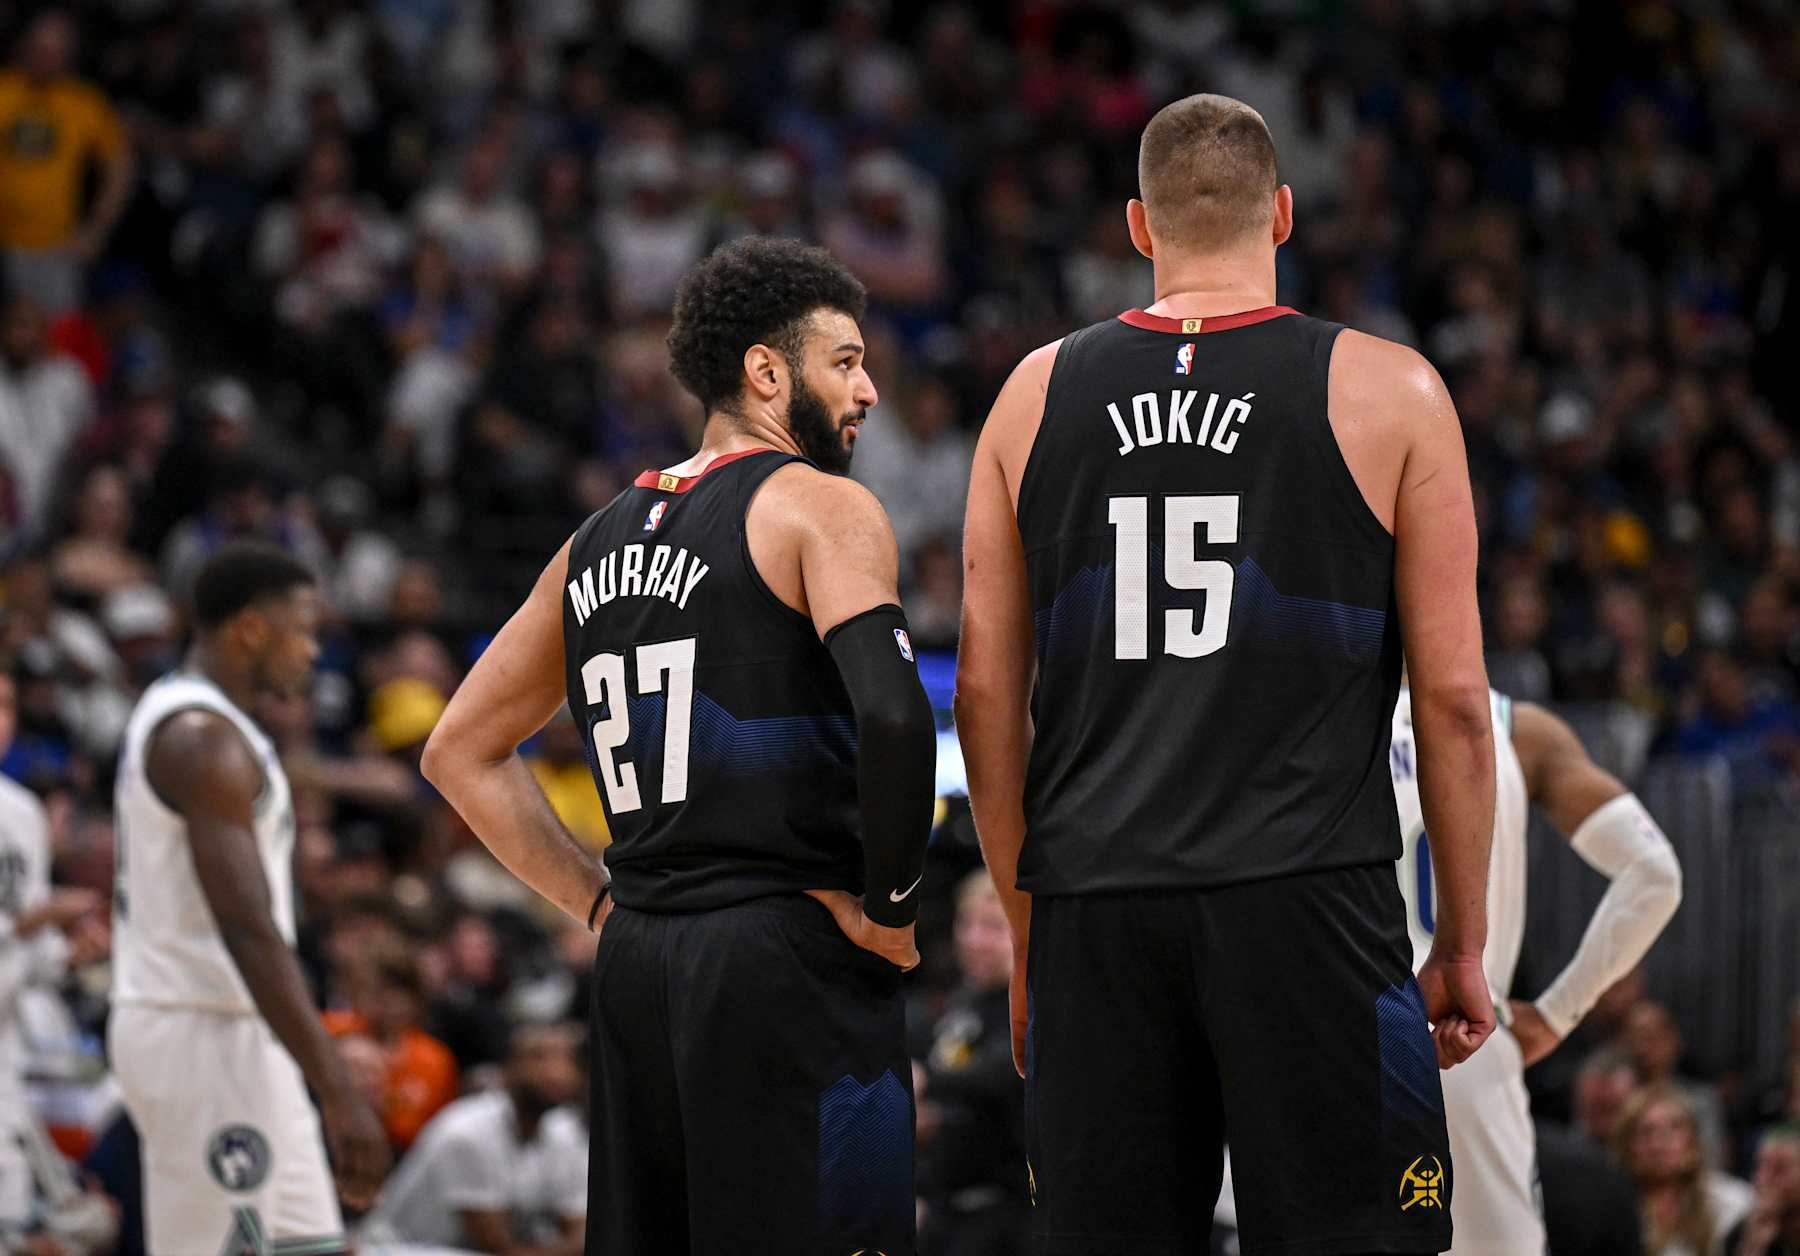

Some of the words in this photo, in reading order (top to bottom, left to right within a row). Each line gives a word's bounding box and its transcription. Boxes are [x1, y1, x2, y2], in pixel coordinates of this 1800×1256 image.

[1106, 389, 1256, 457] JOKIĆ
[568, 543, 710, 627] MURRAY
[1108, 495, 1240, 660] 15
[581, 637, 696, 815] 27
